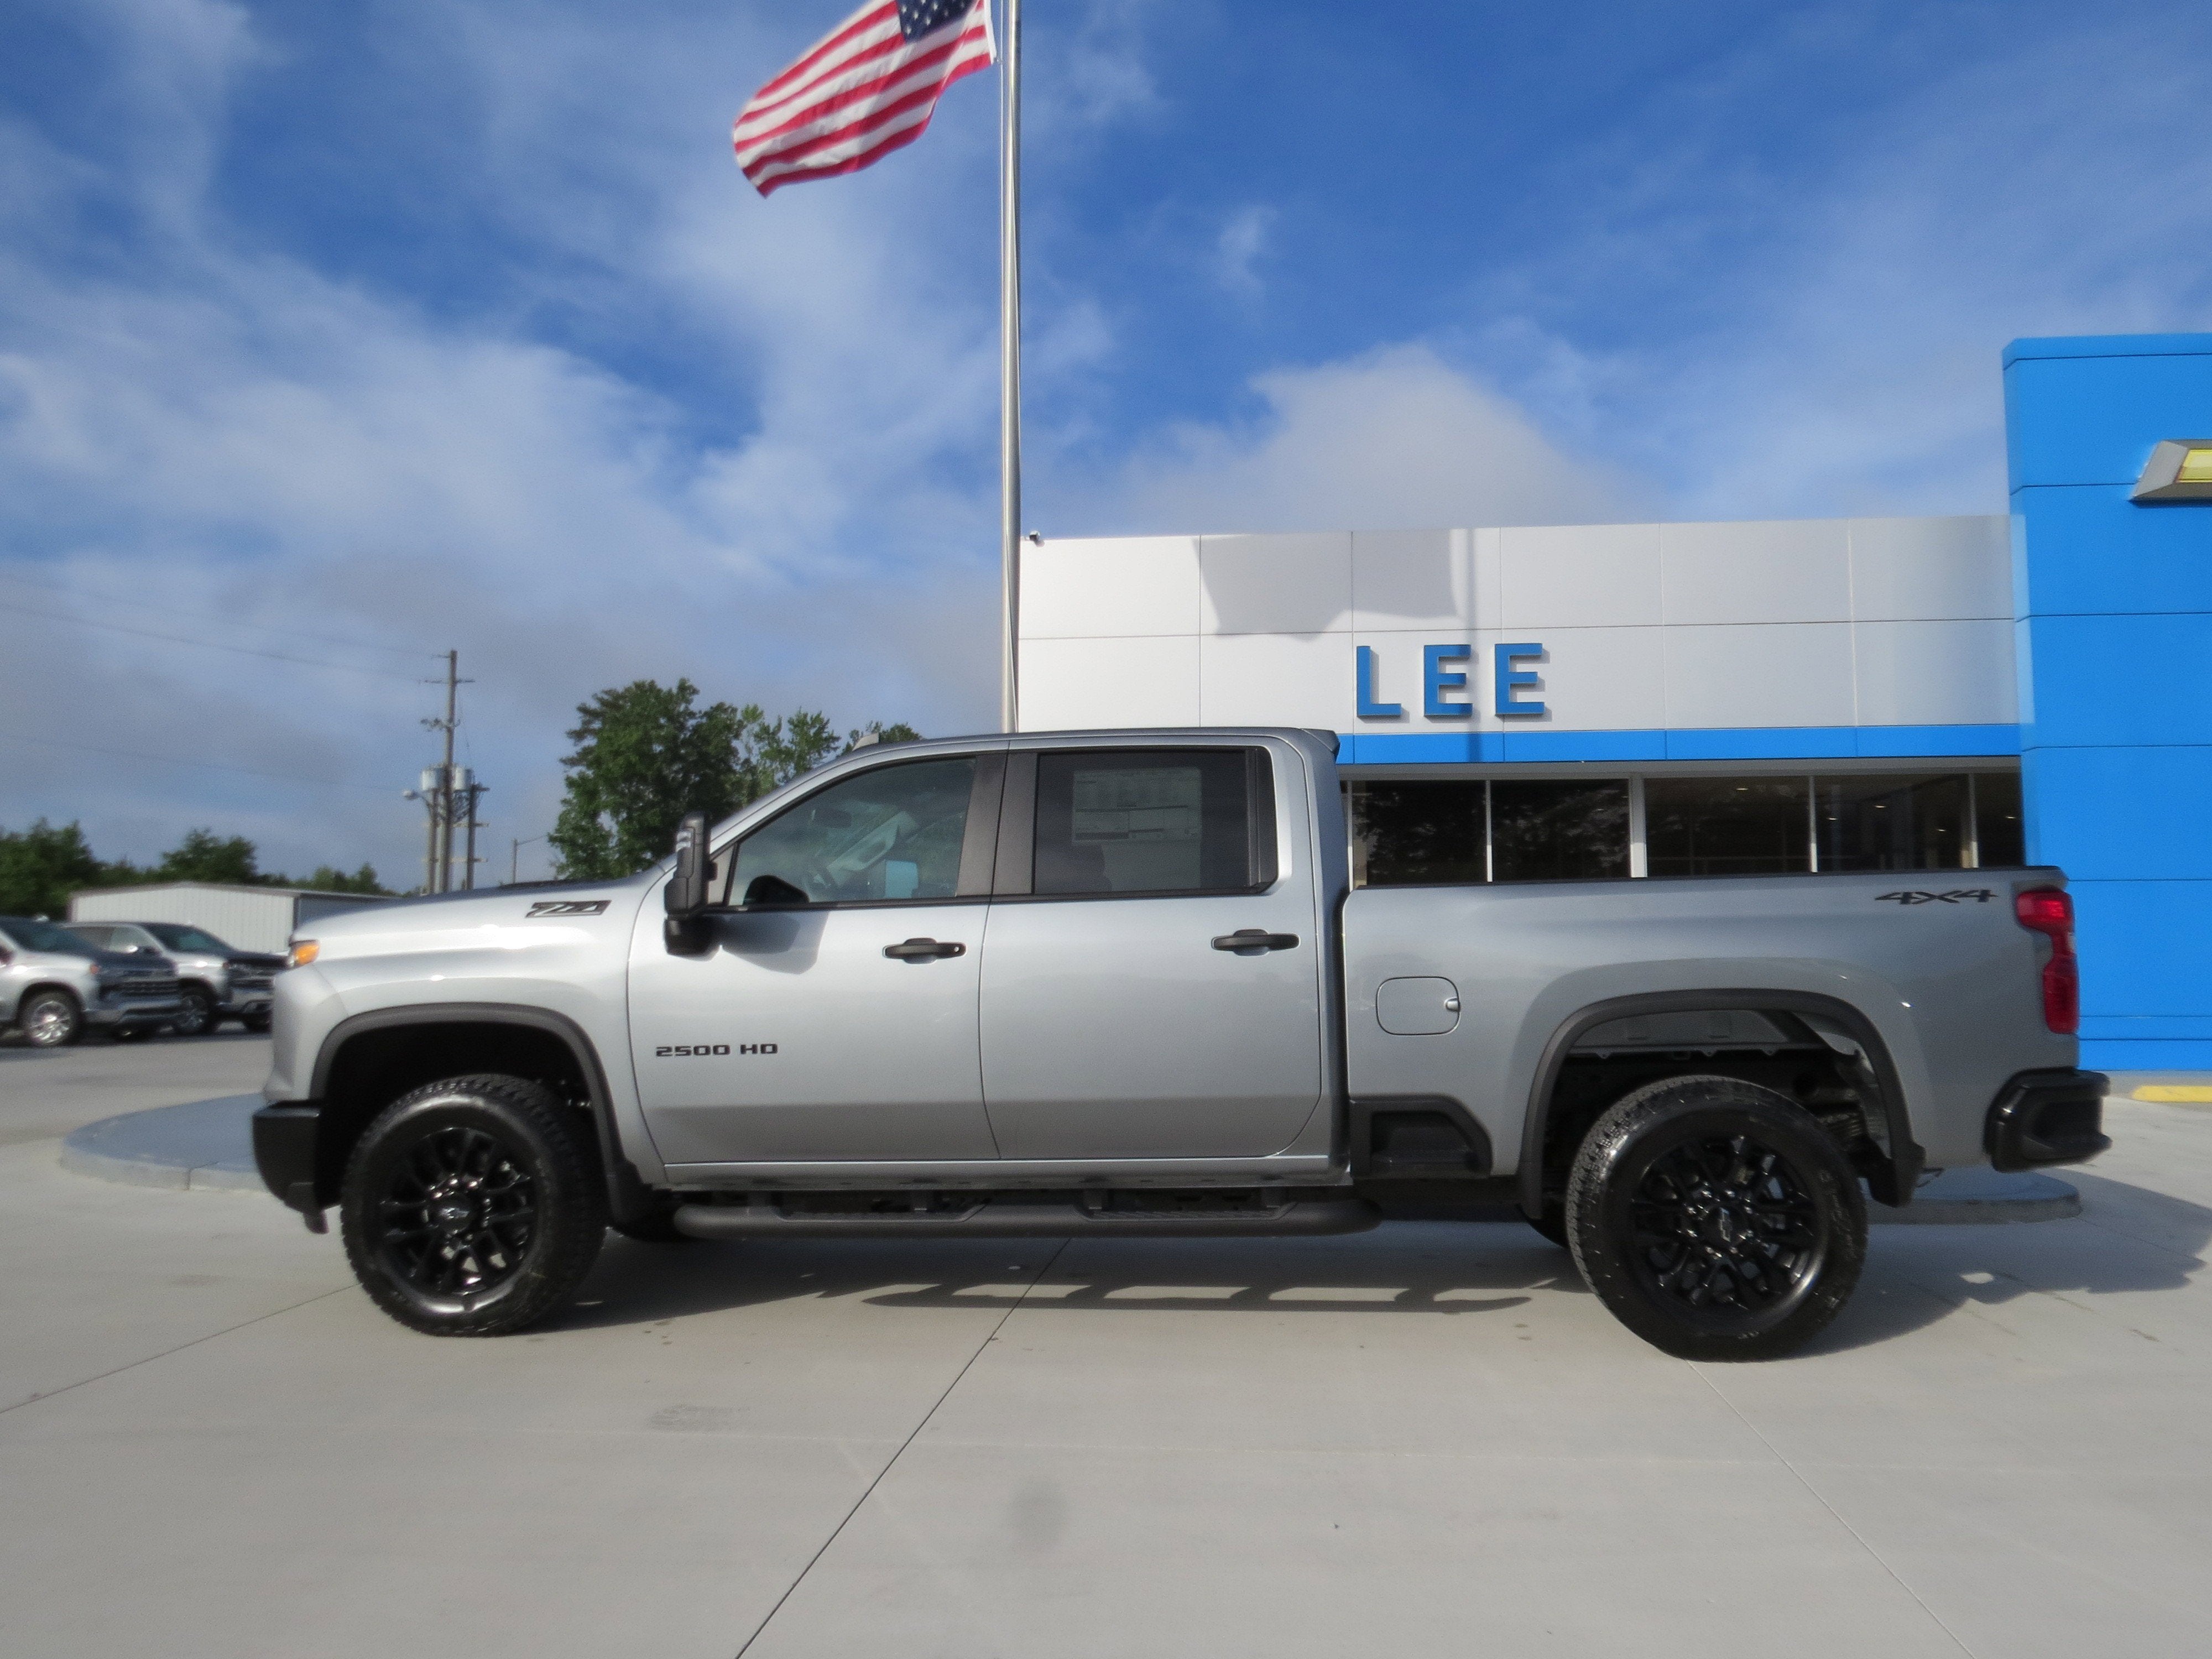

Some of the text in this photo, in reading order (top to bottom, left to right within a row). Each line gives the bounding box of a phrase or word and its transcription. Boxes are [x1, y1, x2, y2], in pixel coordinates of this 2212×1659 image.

[1357, 643, 1545, 716] LEE
[656, 1044, 778, 1057] 2500 HD
